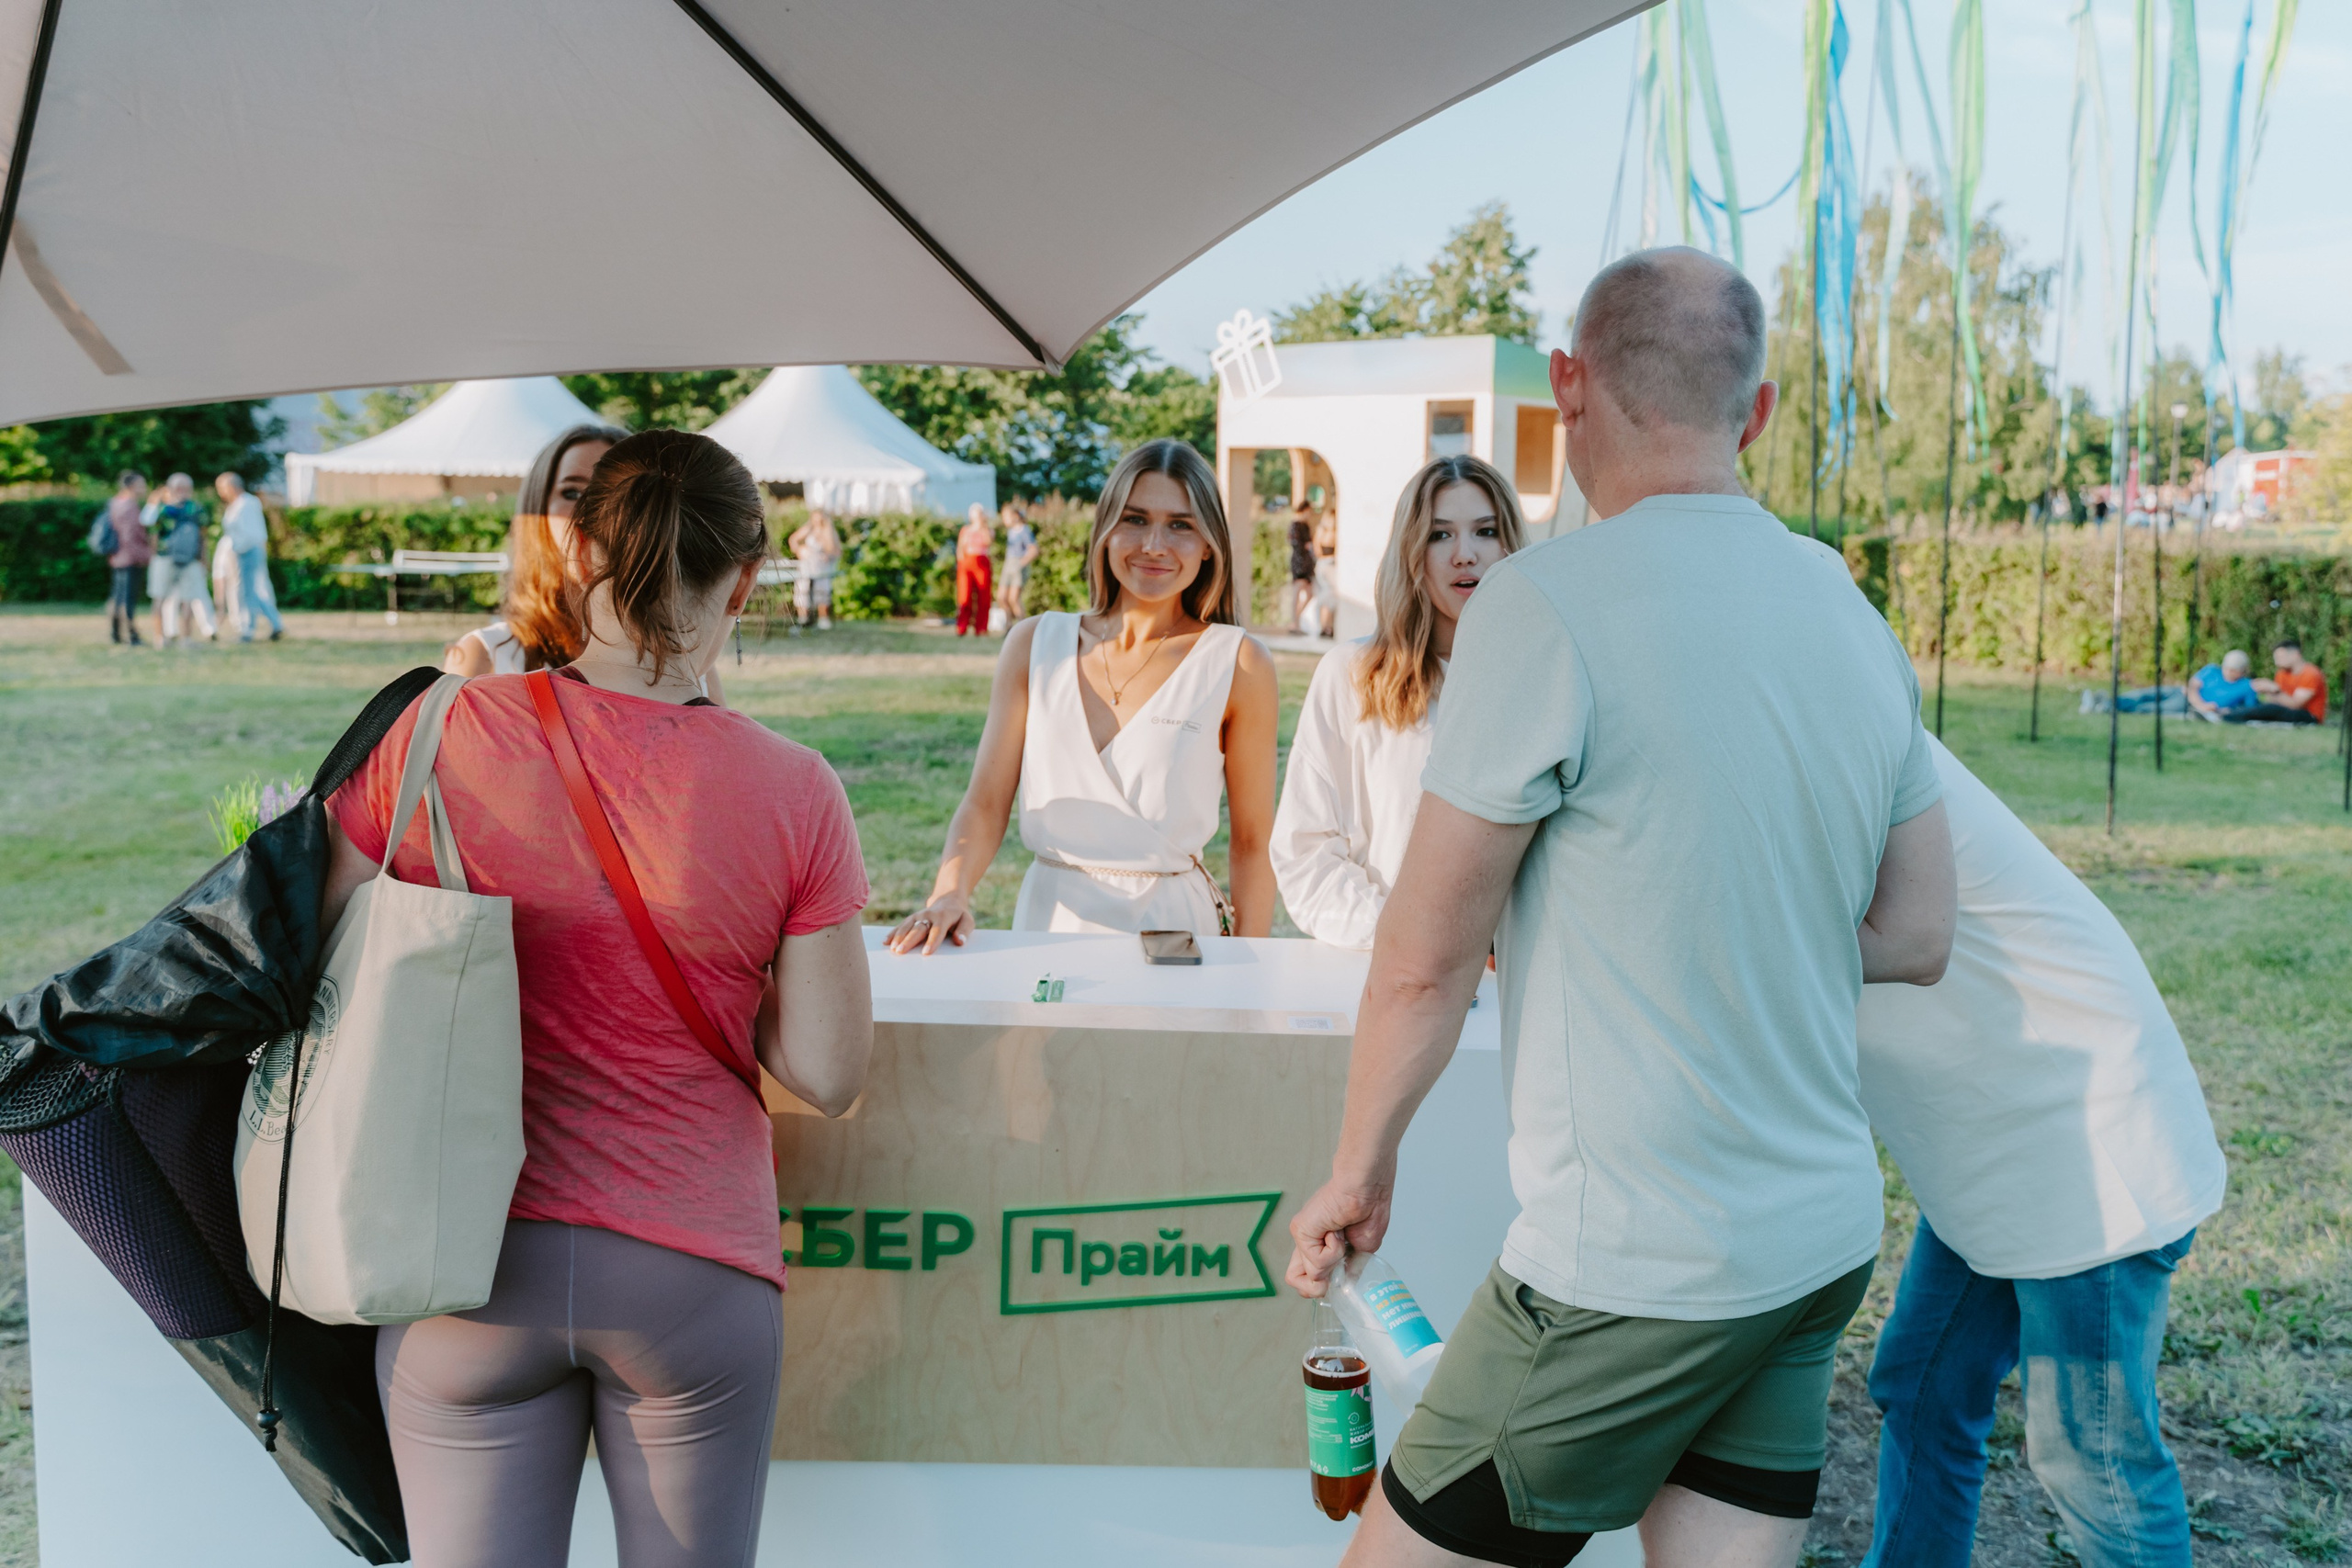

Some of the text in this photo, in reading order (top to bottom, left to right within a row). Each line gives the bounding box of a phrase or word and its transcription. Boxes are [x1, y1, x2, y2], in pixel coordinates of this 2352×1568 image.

[249, 1110, 288, 1136] L.L.Bea
[779, 1206, 1229, 1286] БЕР Прайм
[1388, 1311, 1425, 1330] лишнег
